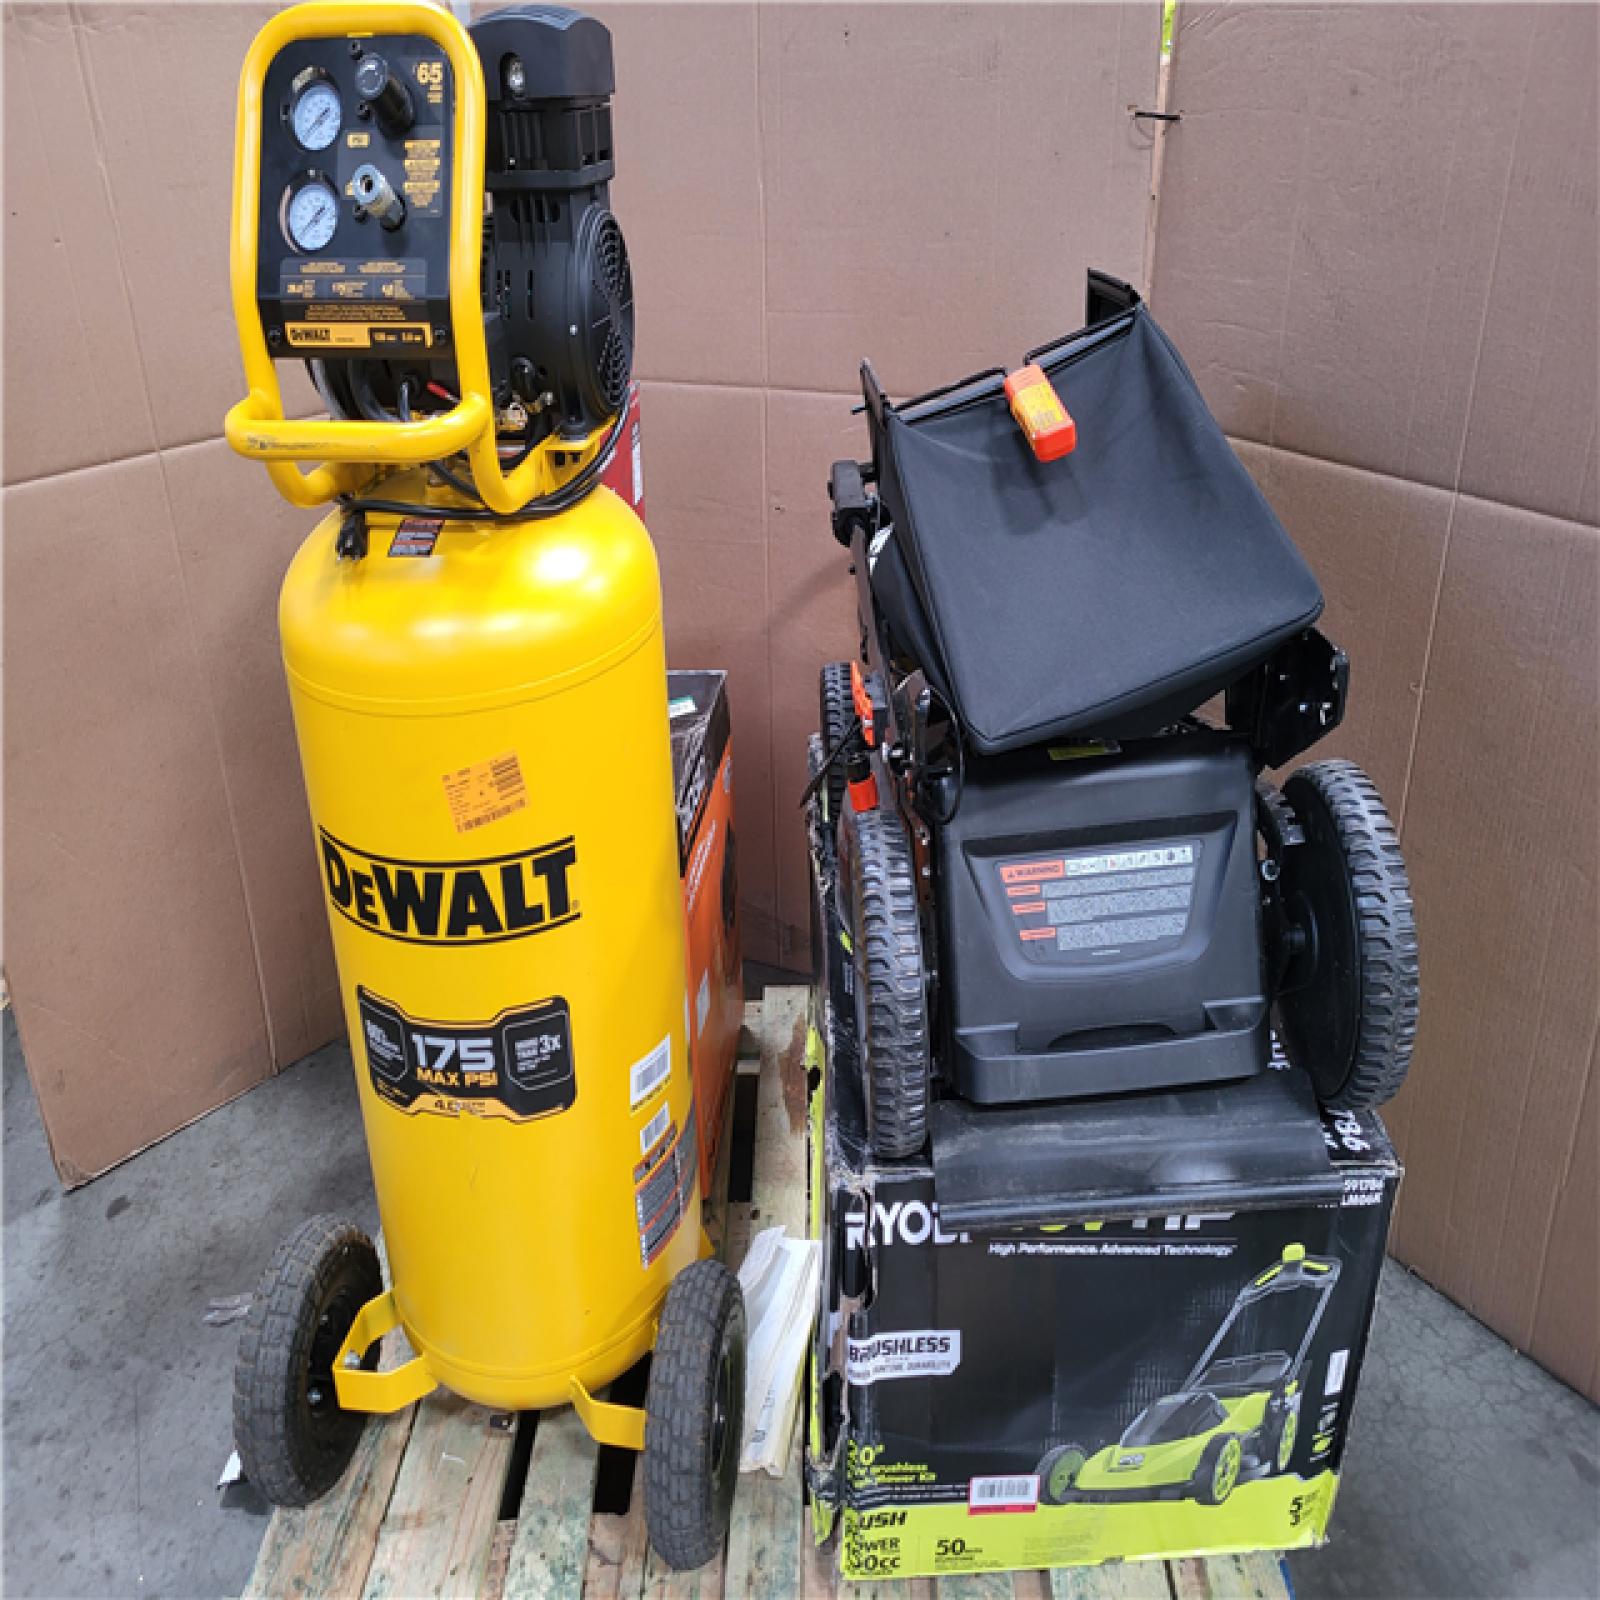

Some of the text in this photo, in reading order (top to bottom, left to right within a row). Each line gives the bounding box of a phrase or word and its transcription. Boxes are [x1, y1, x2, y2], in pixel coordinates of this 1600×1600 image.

[416, 61, 443, 85] 65
[411, 1032, 496, 1072] 175
[415, 1066, 499, 1088] MAX PSI
[988, 1242, 1016, 1257] High
[1100, 1242, 1160, 1256] Advanced
[849, 1336, 951, 1362] BRUSHLESS
[847, 1510, 908, 1531] USH
[935, 1537, 966, 1556] 50
